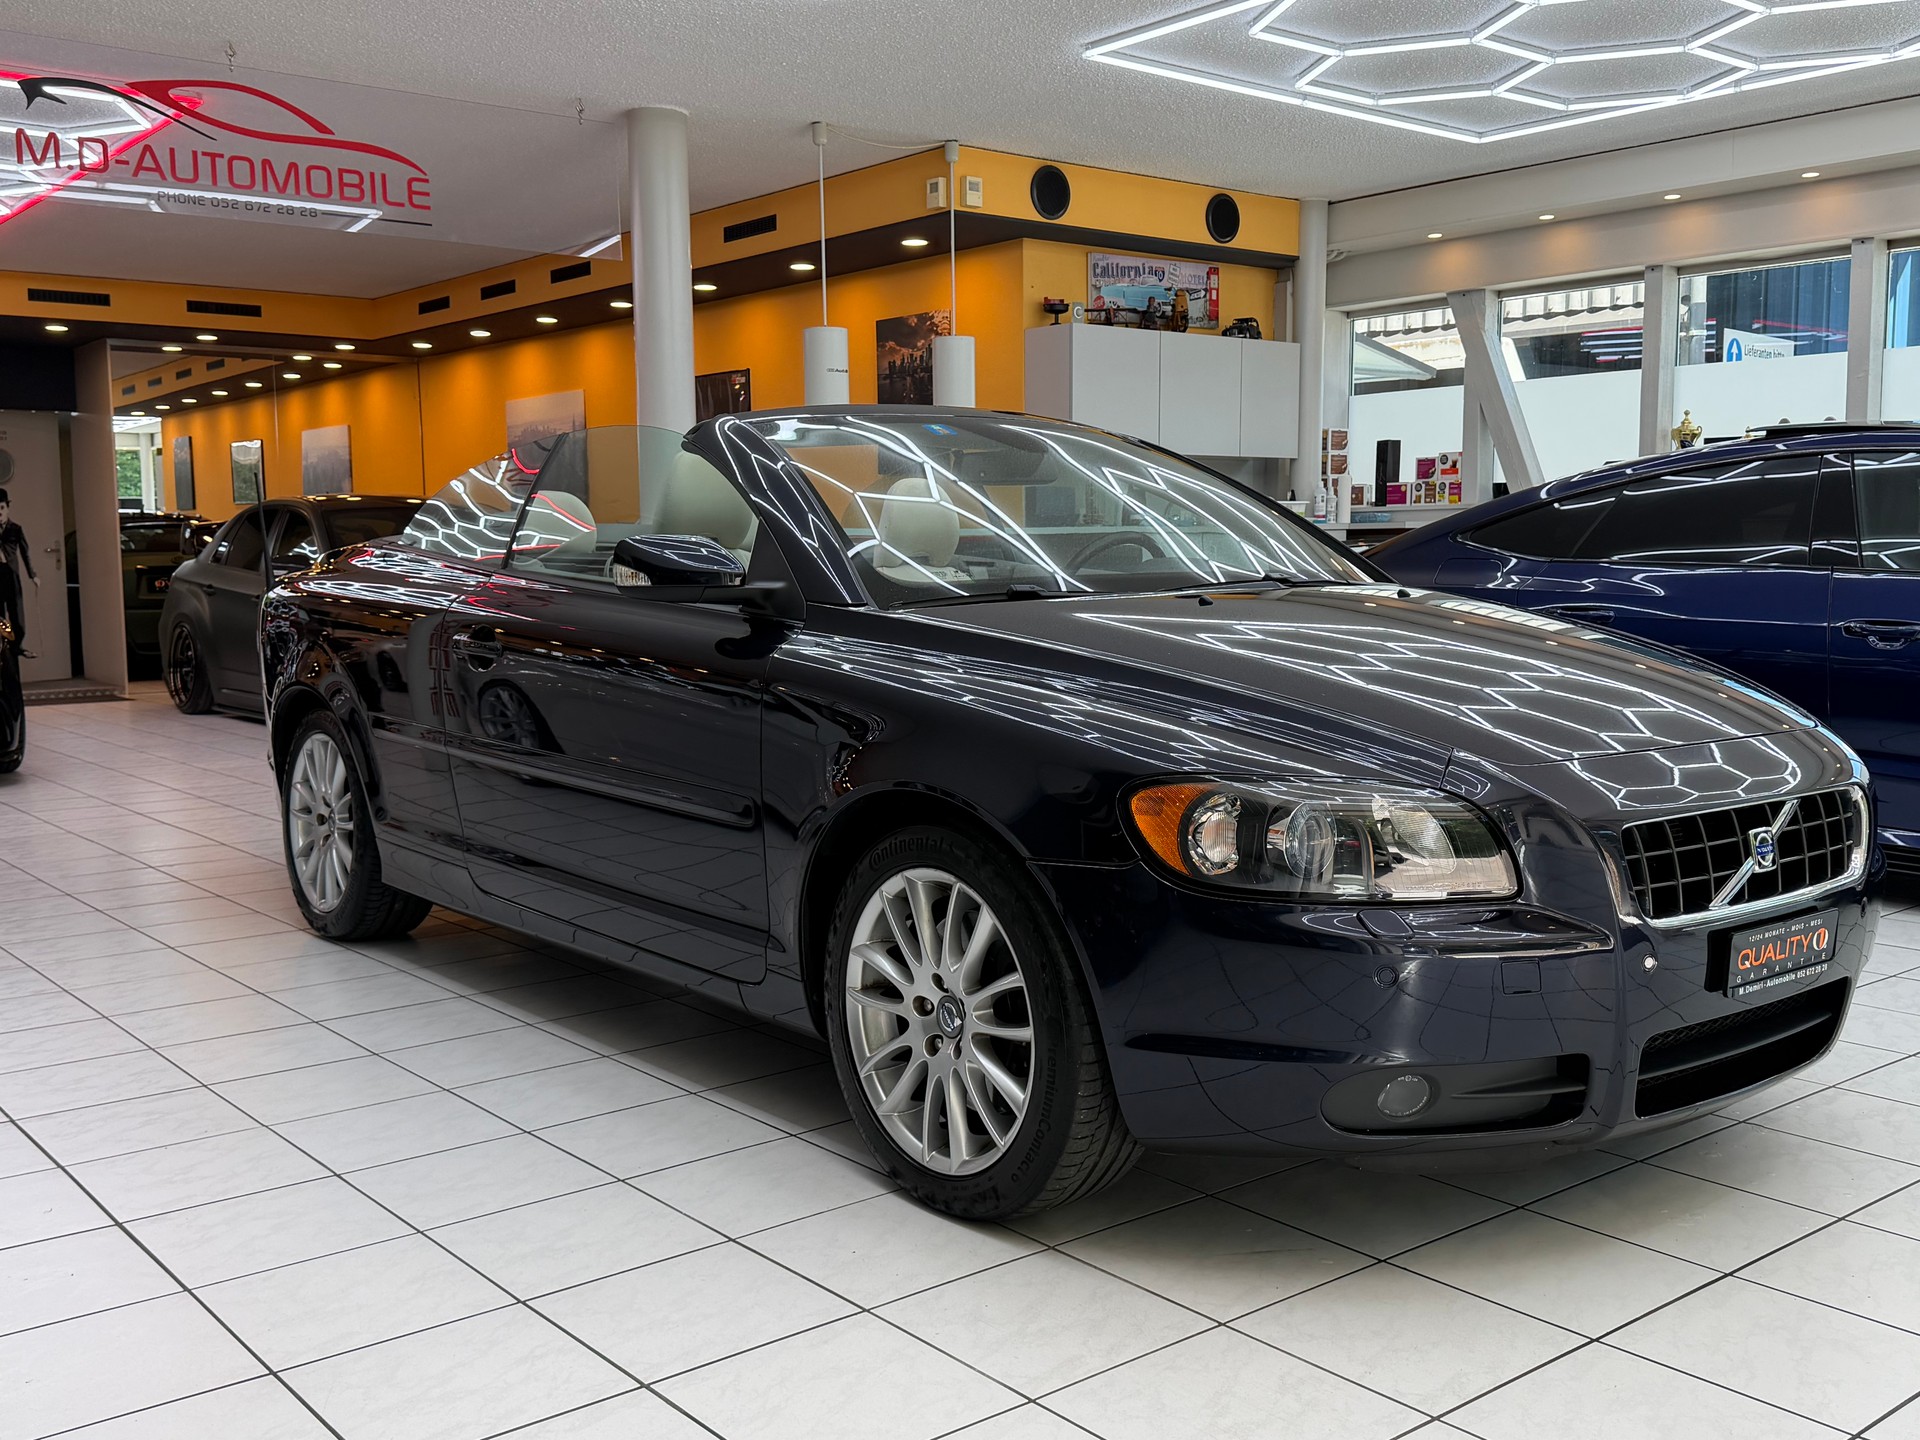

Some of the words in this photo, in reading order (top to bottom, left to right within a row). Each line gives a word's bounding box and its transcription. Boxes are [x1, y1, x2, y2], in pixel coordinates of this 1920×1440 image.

[15, 127, 432, 211] M.D-AUTOMOBILE
[156, 190, 207, 207] PHONE
[210, 196, 240, 210] 052
[244, 199, 272, 214] 672
[276, 203, 296, 217] 28
[299, 206, 319, 219] 28
[1092, 262, 1154, 279] California
[1744, 344, 1773, 360] Lieferanten
[868, 835, 945, 872] Continental
[1749, 935, 1763, 943] 12/24
[1764, 927, 1785, 939] MONATE
[1791, 922, 1805, 931] MOIS
[1810, 918, 1823, 927] MESI
[1737, 932, 1813, 970] QUALITY
[1736, 952, 1827, 983] GARANTIE
